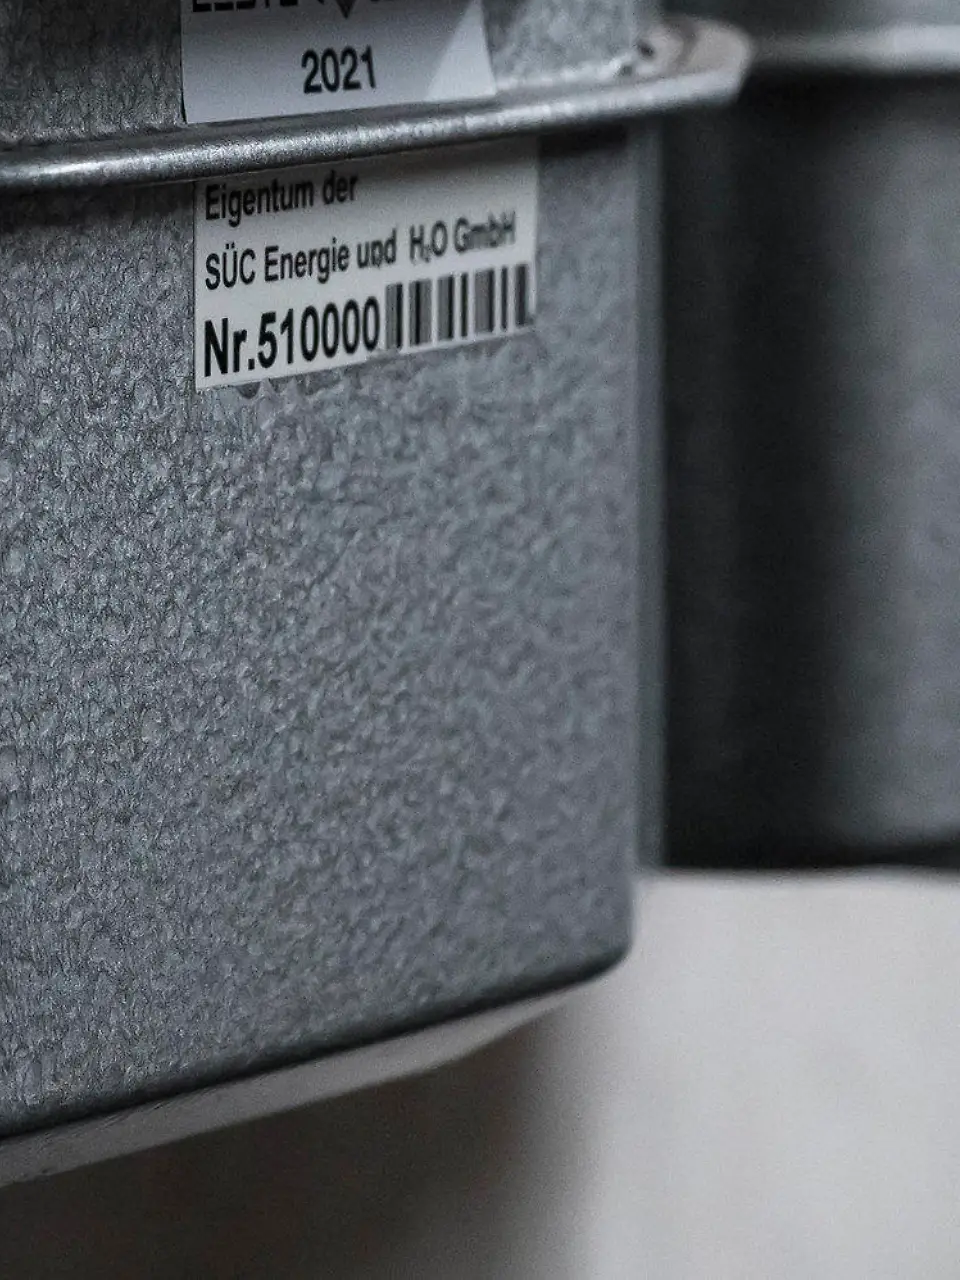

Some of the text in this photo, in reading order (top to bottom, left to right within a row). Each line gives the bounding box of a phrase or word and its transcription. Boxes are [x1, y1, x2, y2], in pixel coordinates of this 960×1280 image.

[301, 45, 376, 94] 2021
[205, 171, 358, 227] Eigentum der
[205, 241, 256, 291] SÜC
[264, 237, 349, 284] Energie
[356, 228, 397, 268] und
[453, 210, 517, 252] GmbH
[204, 295, 381, 377] Nr.510000
